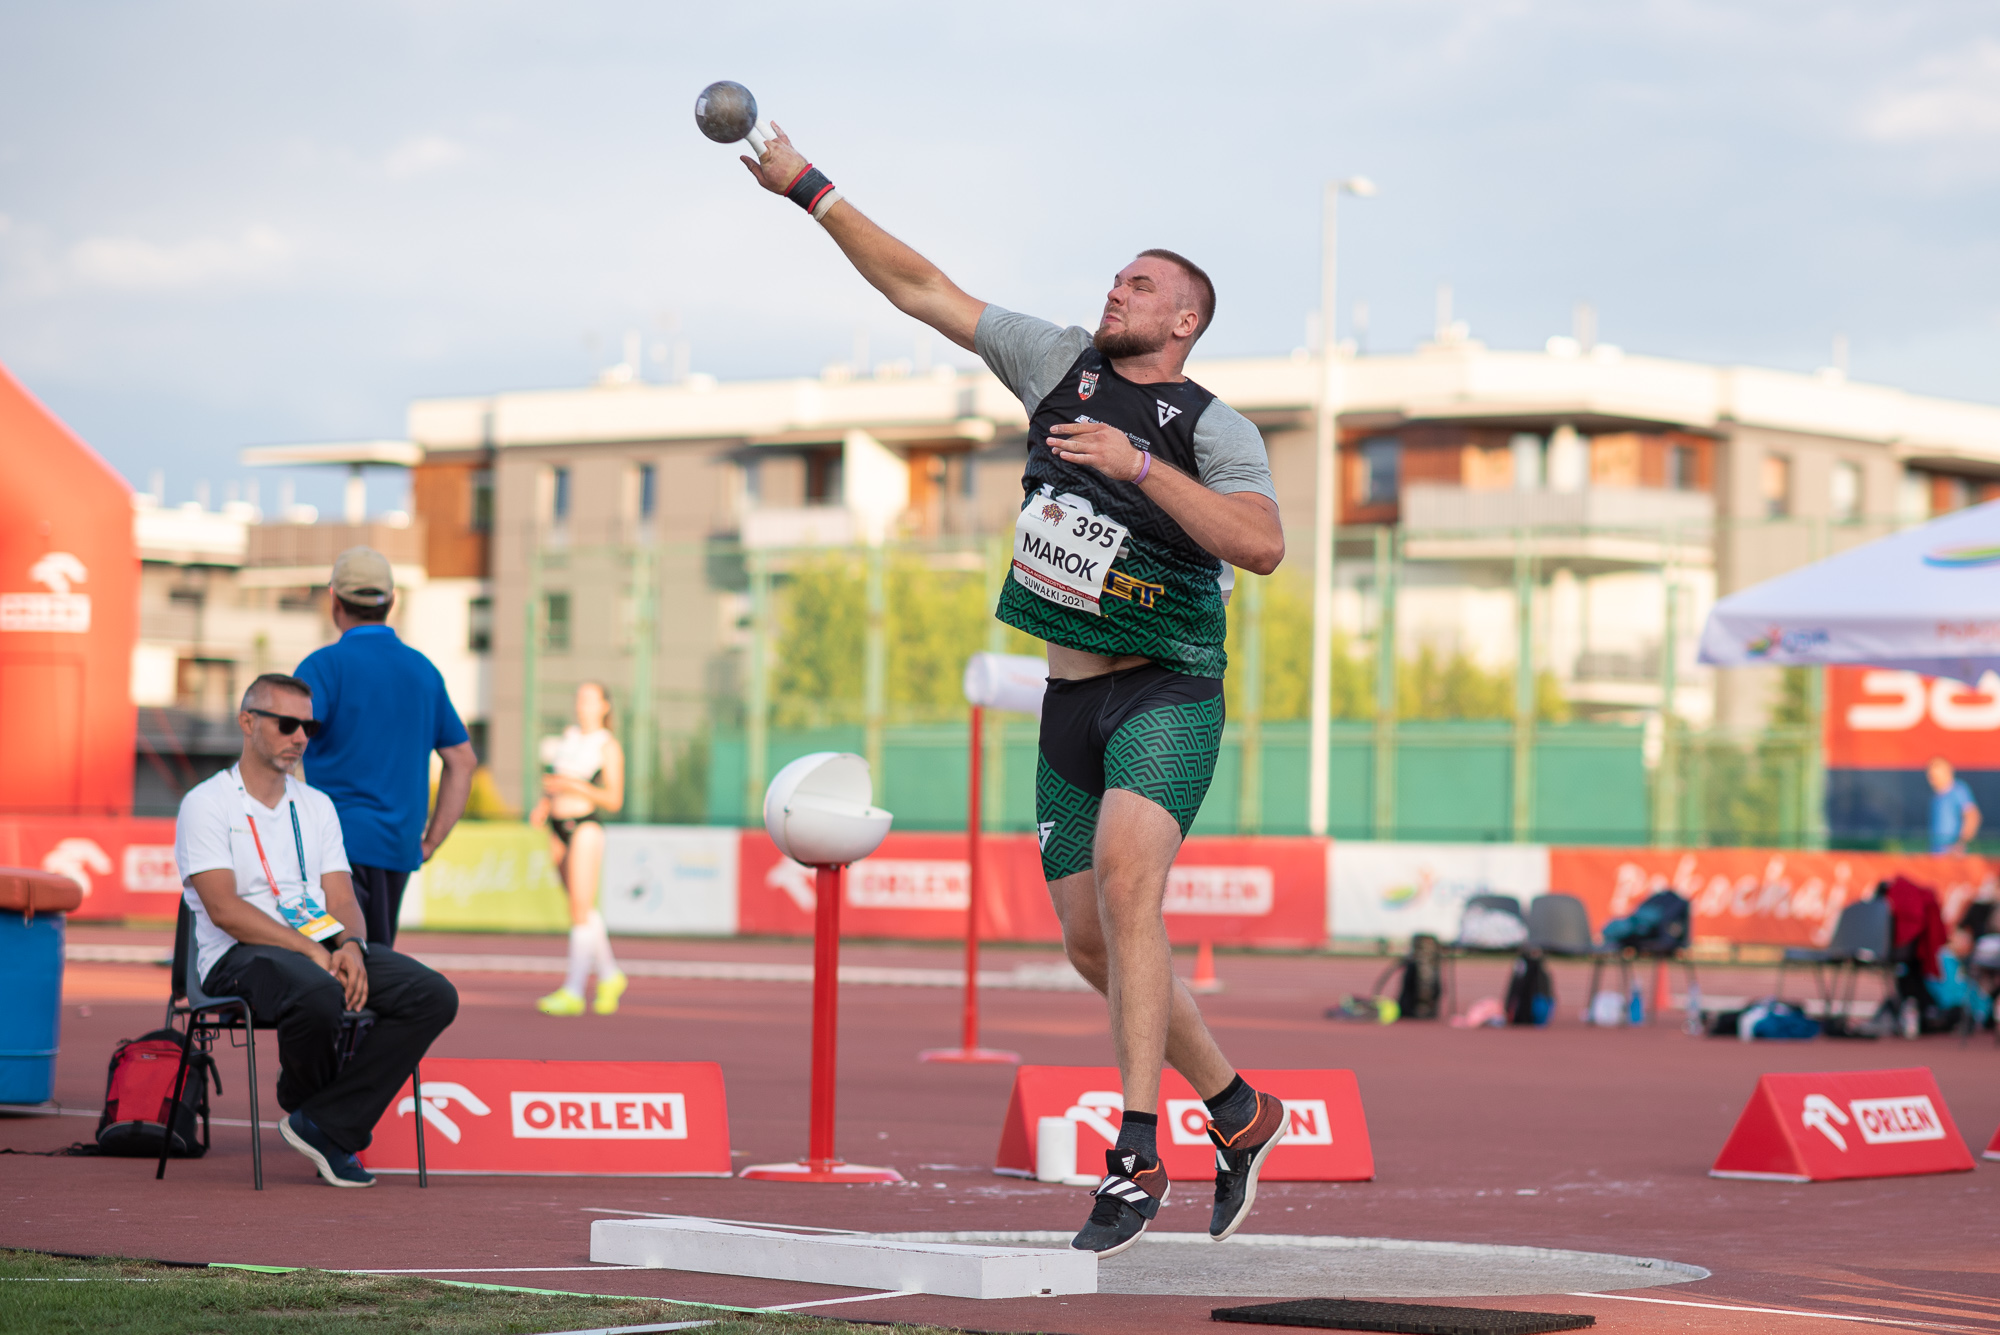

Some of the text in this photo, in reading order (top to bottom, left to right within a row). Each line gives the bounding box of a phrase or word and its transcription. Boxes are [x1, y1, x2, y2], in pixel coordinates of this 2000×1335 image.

[1072, 516, 1118, 548] 395
[1023, 532, 1099, 582] MAROK
[1024, 575, 1085, 608] SUWAŁKI 2021
[523, 1101, 673, 1130] ORLEN
[1861, 1105, 1936, 1134] ORLEN
